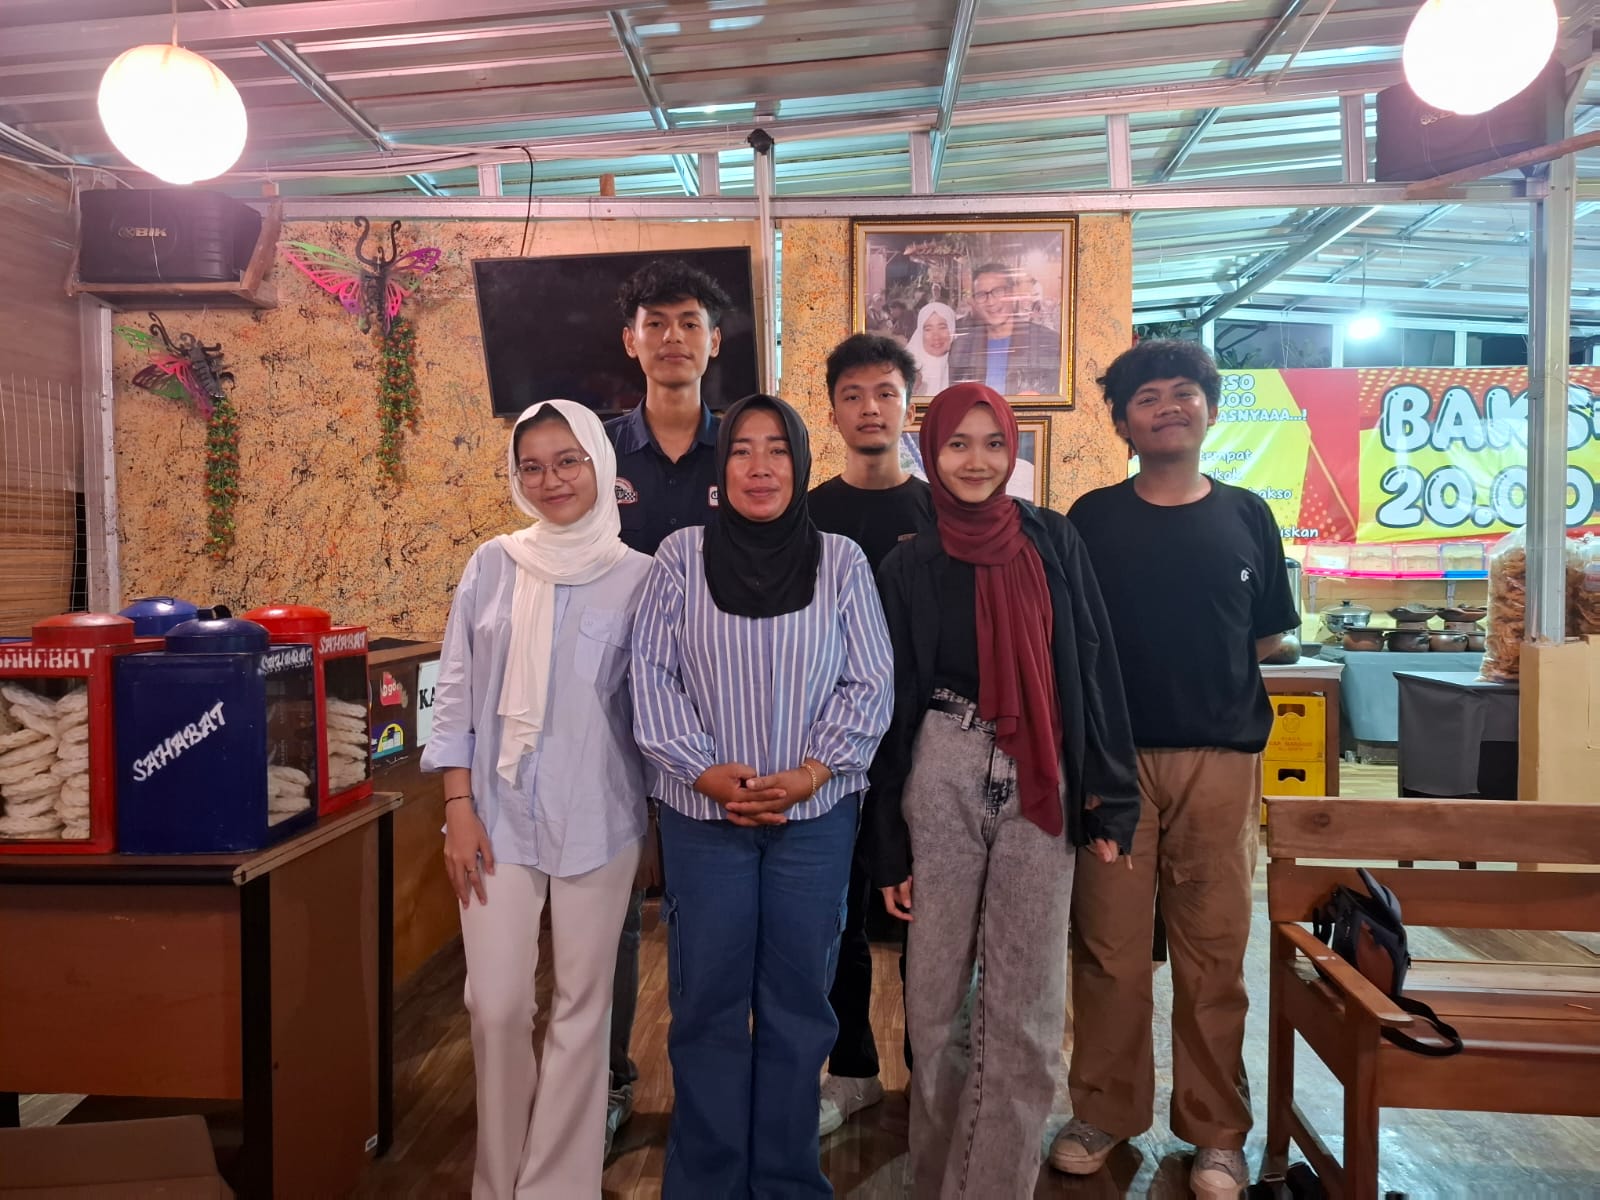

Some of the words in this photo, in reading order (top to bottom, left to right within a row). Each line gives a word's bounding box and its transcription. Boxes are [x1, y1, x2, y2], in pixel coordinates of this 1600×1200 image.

[1216, 408, 1308, 423] ASNYAAA...!
[319, 631, 367, 654] SAHABAT
[0, 648, 96, 670] AHABAT
[133, 699, 226, 781] SAHABAT
